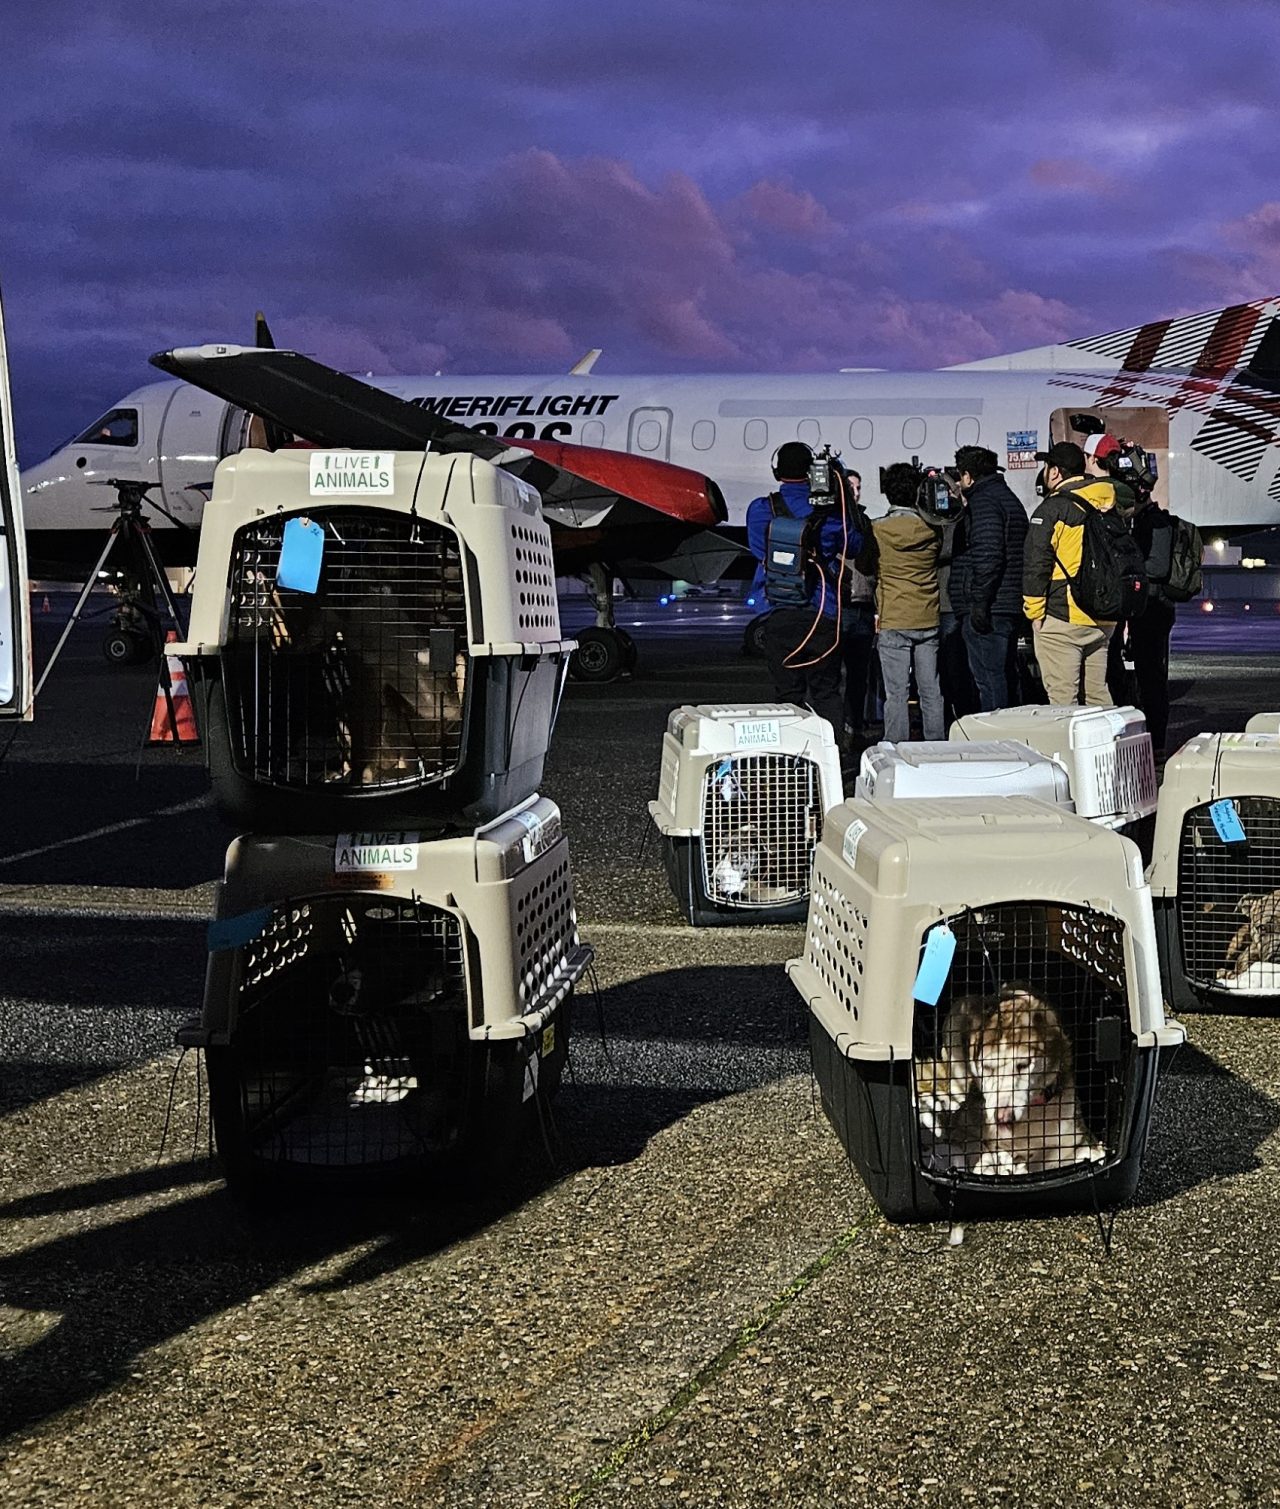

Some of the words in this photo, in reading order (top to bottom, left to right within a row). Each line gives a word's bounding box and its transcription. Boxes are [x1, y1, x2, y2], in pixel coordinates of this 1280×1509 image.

[410, 395, 619, 417] MERIFLIGHT
[334, 456, 370, 469] LIVE
[314, 471, 389, 488] ANIMALS
[747, 723, 767, 734] LIVE
[738, 732, 778, 745] ANIMALS
[359, 833, 397, 846] LIVE
[339, 847, 413, 866] ANIMALS
